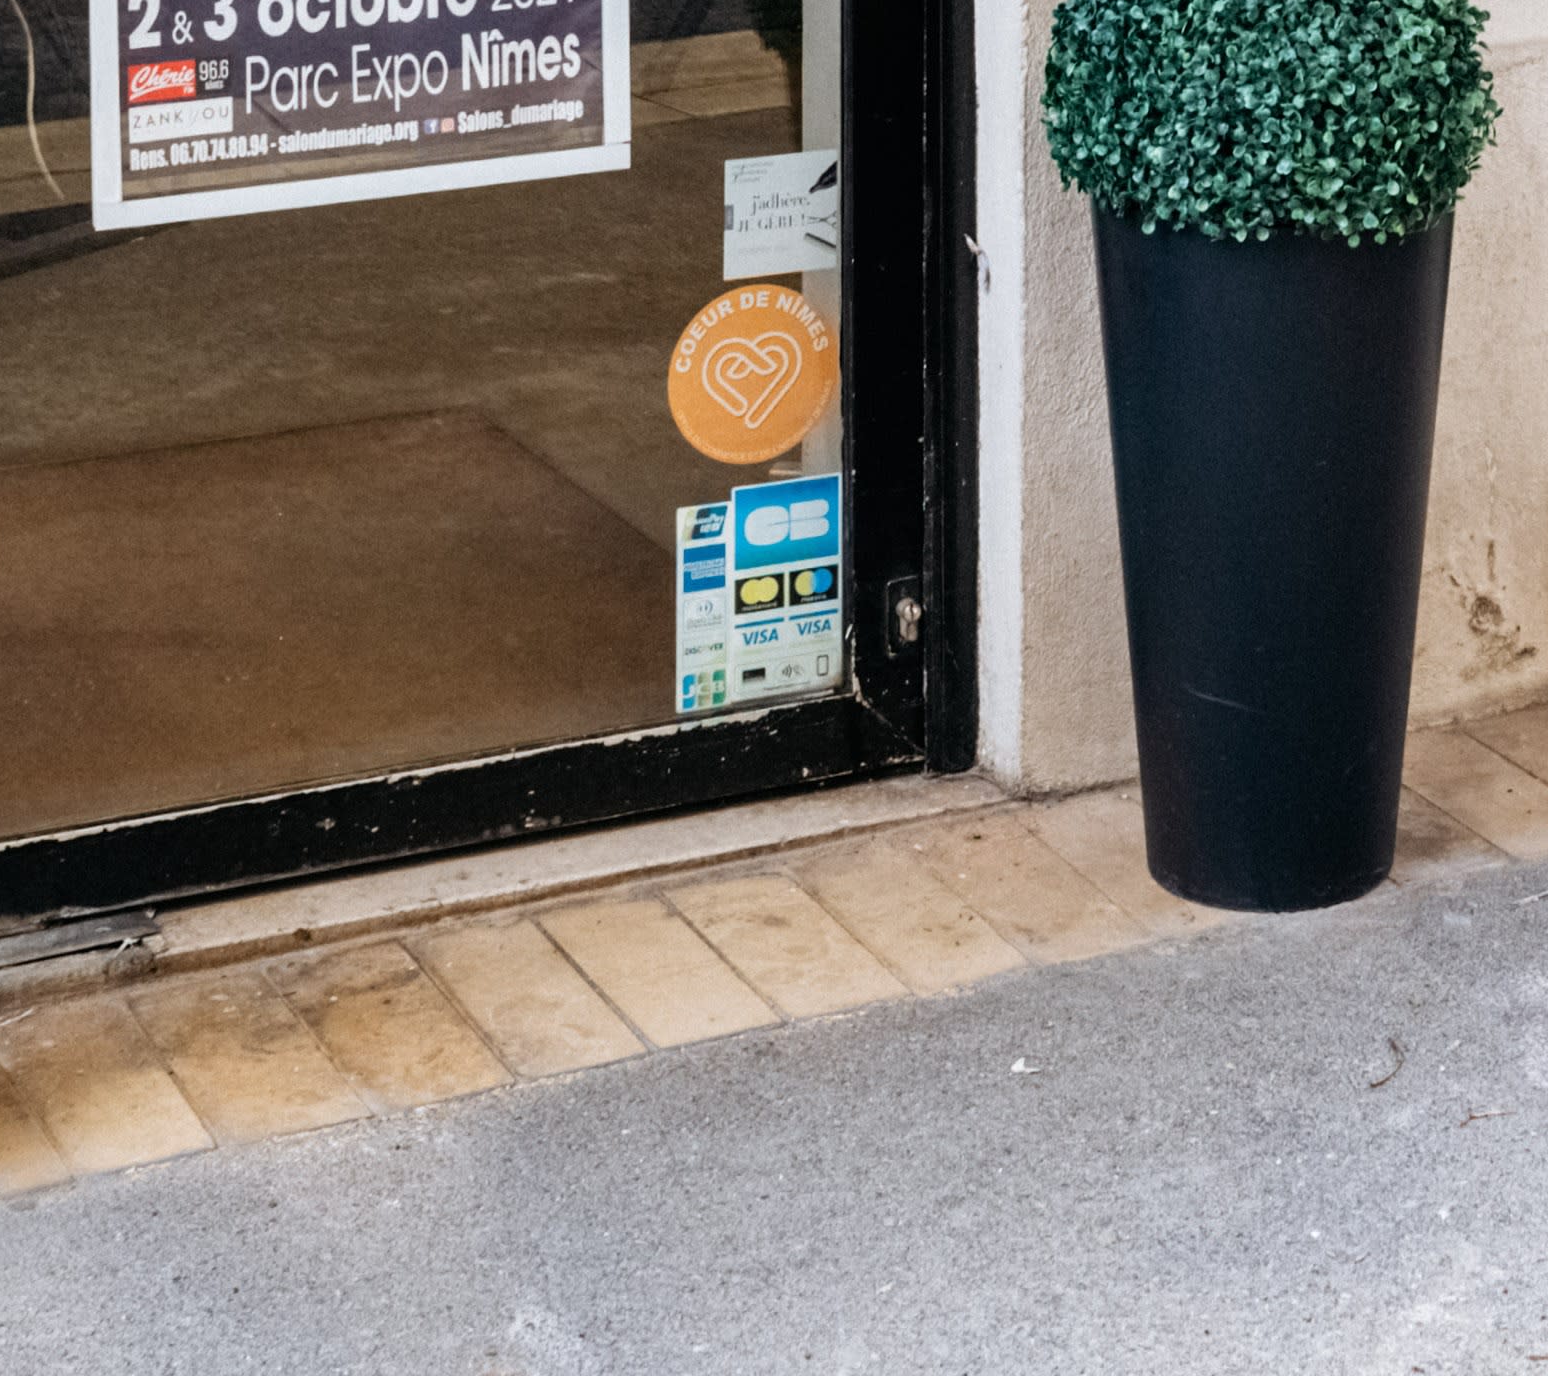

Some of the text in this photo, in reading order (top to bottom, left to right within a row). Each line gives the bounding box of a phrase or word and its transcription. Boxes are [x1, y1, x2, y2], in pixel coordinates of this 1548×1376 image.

[172, 10, 194, 45] &
[198, 58, 230, 82] 96.6
[244, 29, 582, 115] Parc Expo Nîmes
[129, 146, 169, 172] Rens.
[278, 119, 420, 153] salondumariage.org
[457, 97, 584, 135] Salons_dumariage
[675, 299, 736, 374] COEUR
[739, 290, 772, 310] DE
[744, 498, 830, 547] CB
[742, 628, 780, 647] VISA
[797, 619, 832, 637] VISA
[685, 642, 725, 656] DISCVER
